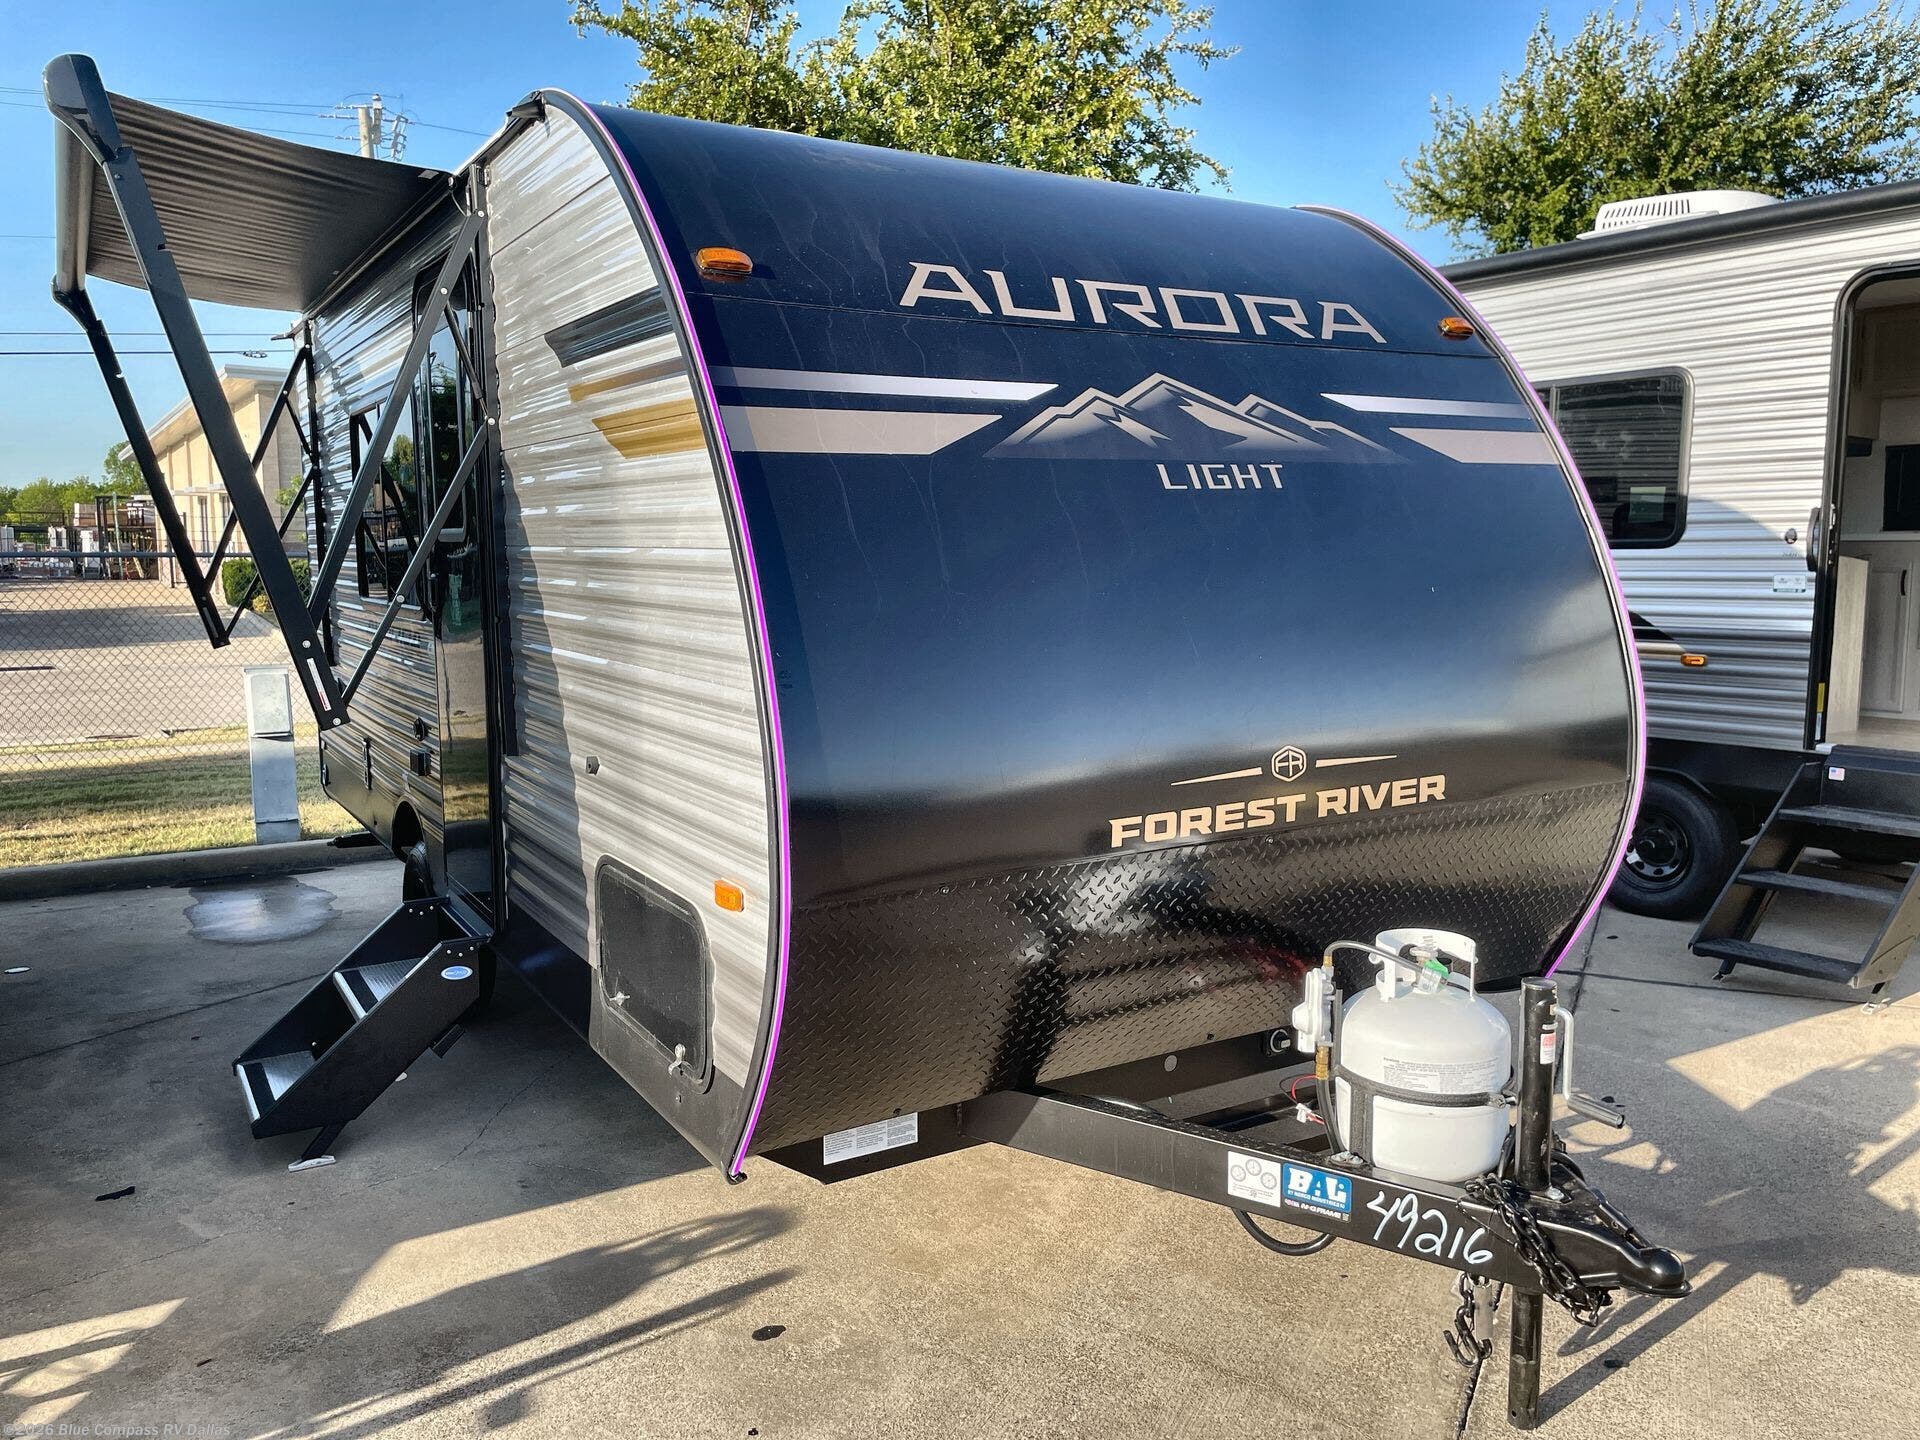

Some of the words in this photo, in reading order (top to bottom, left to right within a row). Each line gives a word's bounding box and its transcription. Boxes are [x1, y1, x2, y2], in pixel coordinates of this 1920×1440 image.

[899, 261, 1387, 343] AURORA
[1156, 463, 1283, 490] LIGHT
[1109, 794, 1307, 849] FOREST
[1316, 774, 1447, 819] RIVER
[1366, 1190, 1493, 1264] 49216
